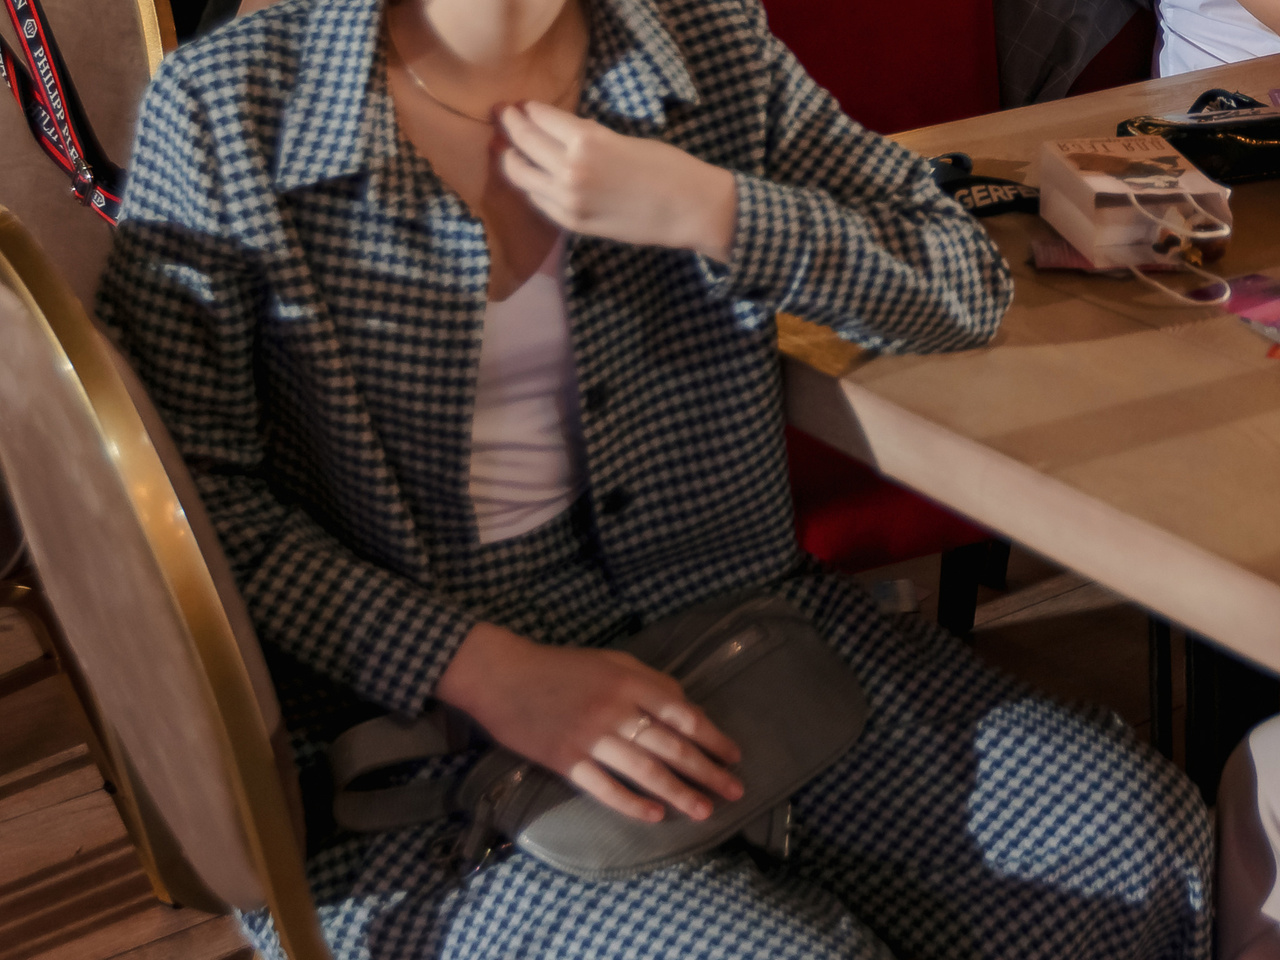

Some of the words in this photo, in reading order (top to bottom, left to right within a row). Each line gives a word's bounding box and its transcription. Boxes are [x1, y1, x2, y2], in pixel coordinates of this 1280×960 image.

[33, 45, 66, 121] PHILIPP
[62, 122, 79, 164] PLE
[954, 184, 1039, 209] GERFE
